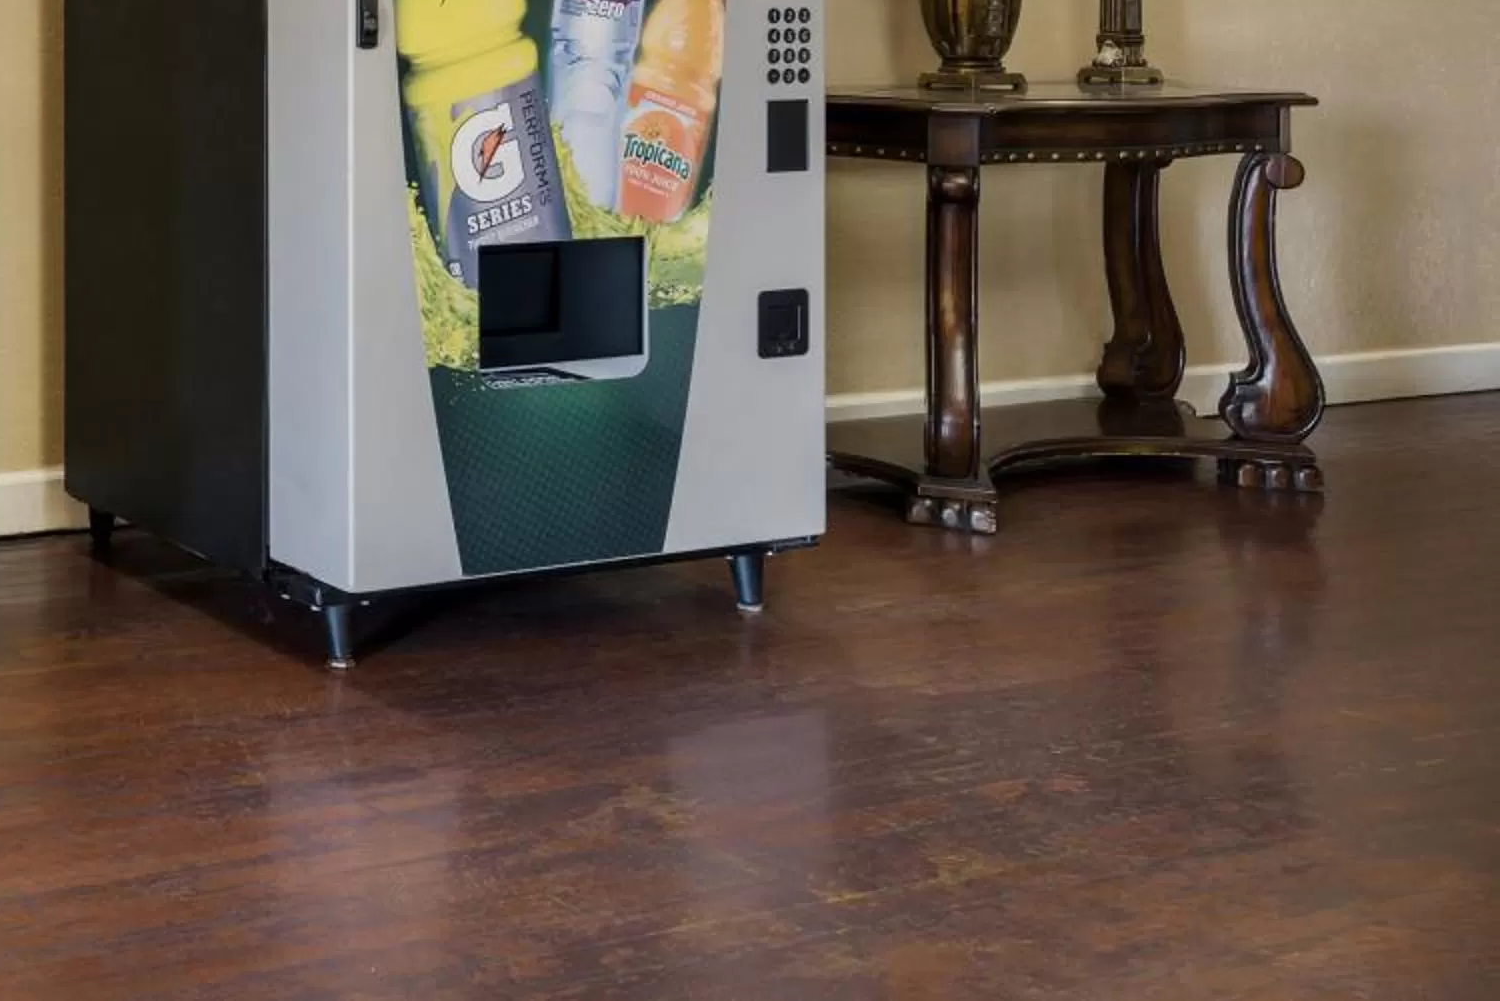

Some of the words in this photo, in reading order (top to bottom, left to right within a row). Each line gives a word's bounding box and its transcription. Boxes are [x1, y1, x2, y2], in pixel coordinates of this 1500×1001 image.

[451, 102, 524, 204] G
[624, 133, 690, 180] Tropicana
[467, 194, 532, 235] SERIES
